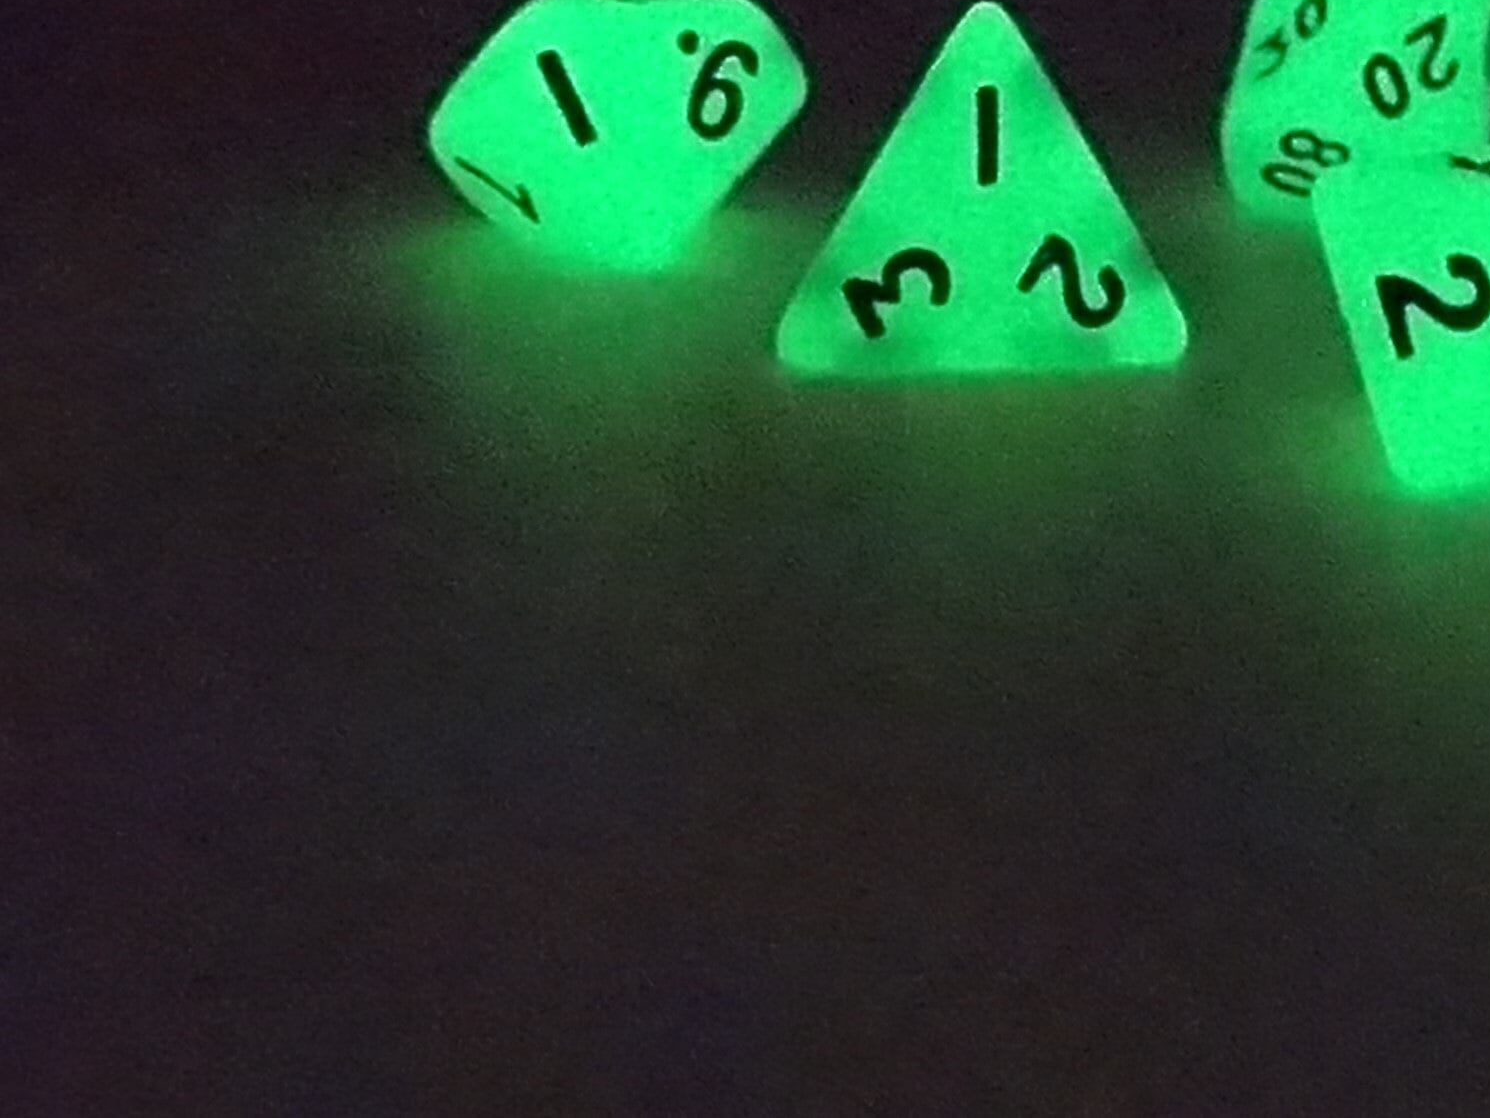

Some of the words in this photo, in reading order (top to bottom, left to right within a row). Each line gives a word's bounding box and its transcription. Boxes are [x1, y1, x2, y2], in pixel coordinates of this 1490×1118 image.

[536, 49, 598, 147] 1
[1362, 14, 1459, 120] 20
[974, 84, 999, 187] 1
[1260, 129, 1350, 198] 80
[841, 247, 952, 340] 3
[1017, 234, 1126, 329] 2
